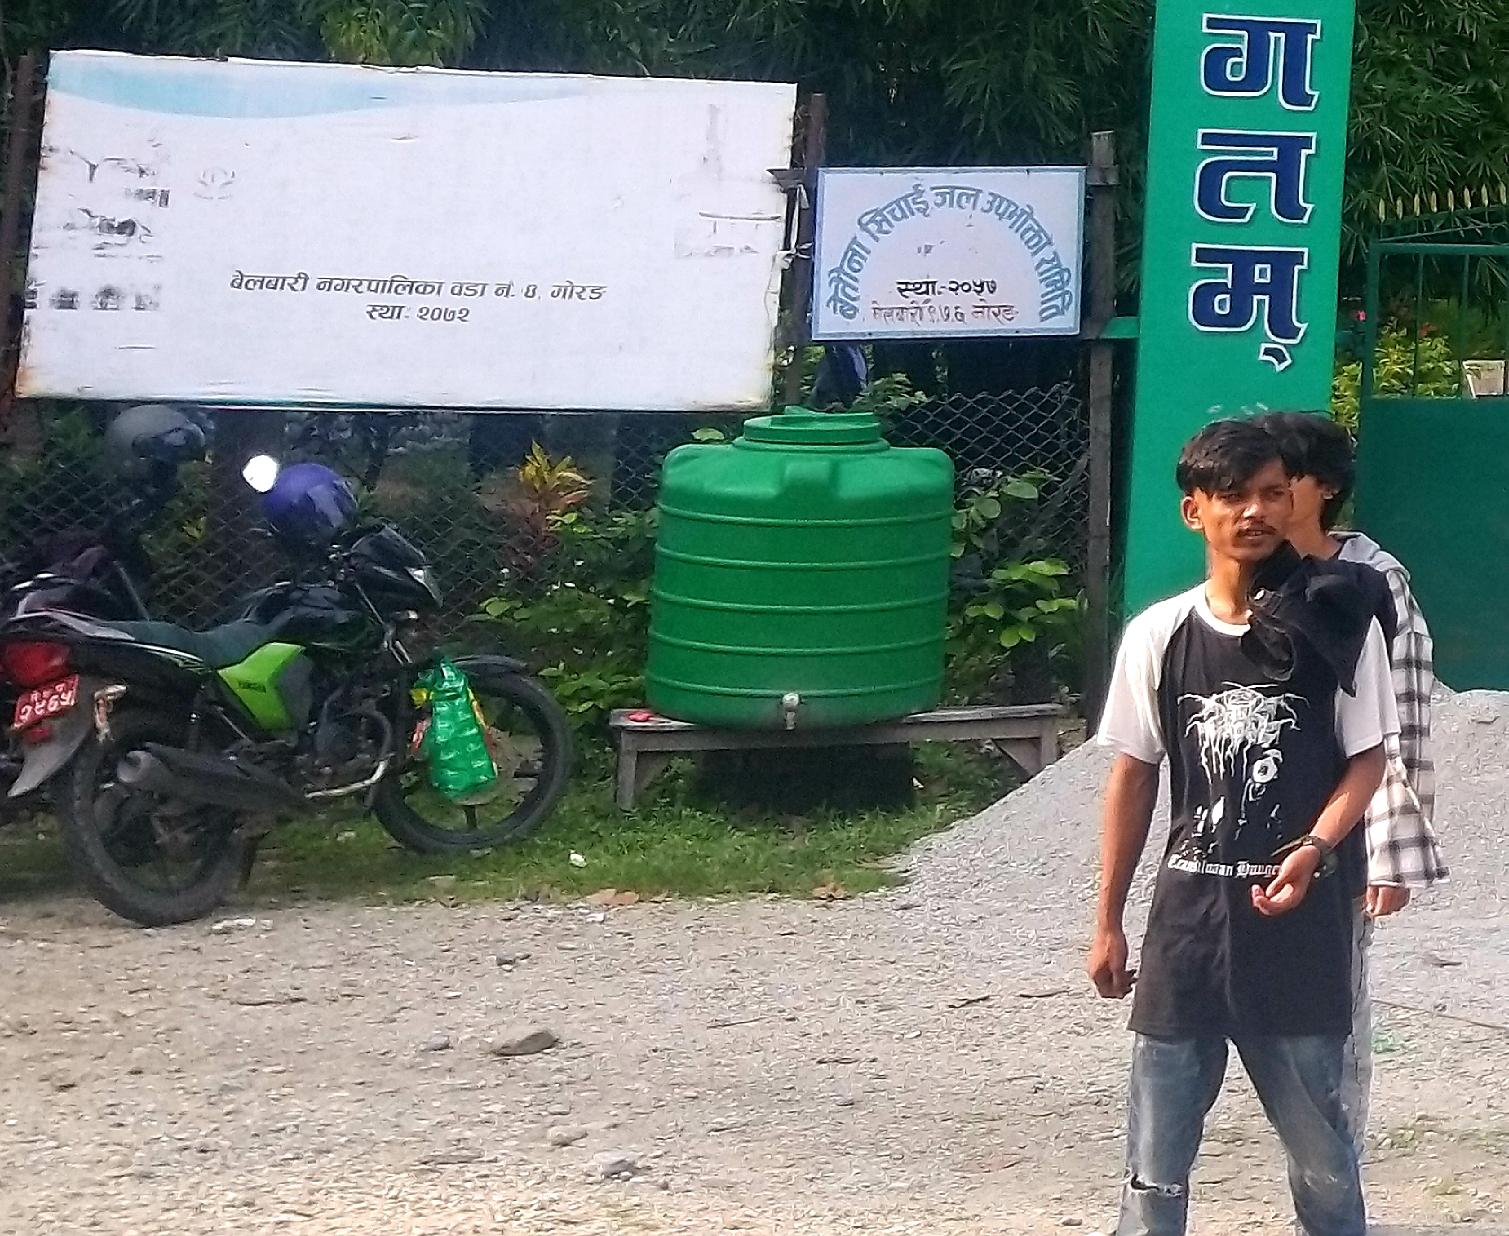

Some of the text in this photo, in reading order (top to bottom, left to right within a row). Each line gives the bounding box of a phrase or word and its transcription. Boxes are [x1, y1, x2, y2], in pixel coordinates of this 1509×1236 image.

[930, 184, 983, 212] जल
[316, 274, 446, 296] नगरपालिका
[450, 280, 489, 297] वडा
[417, 307, 471, 324] २०७२
